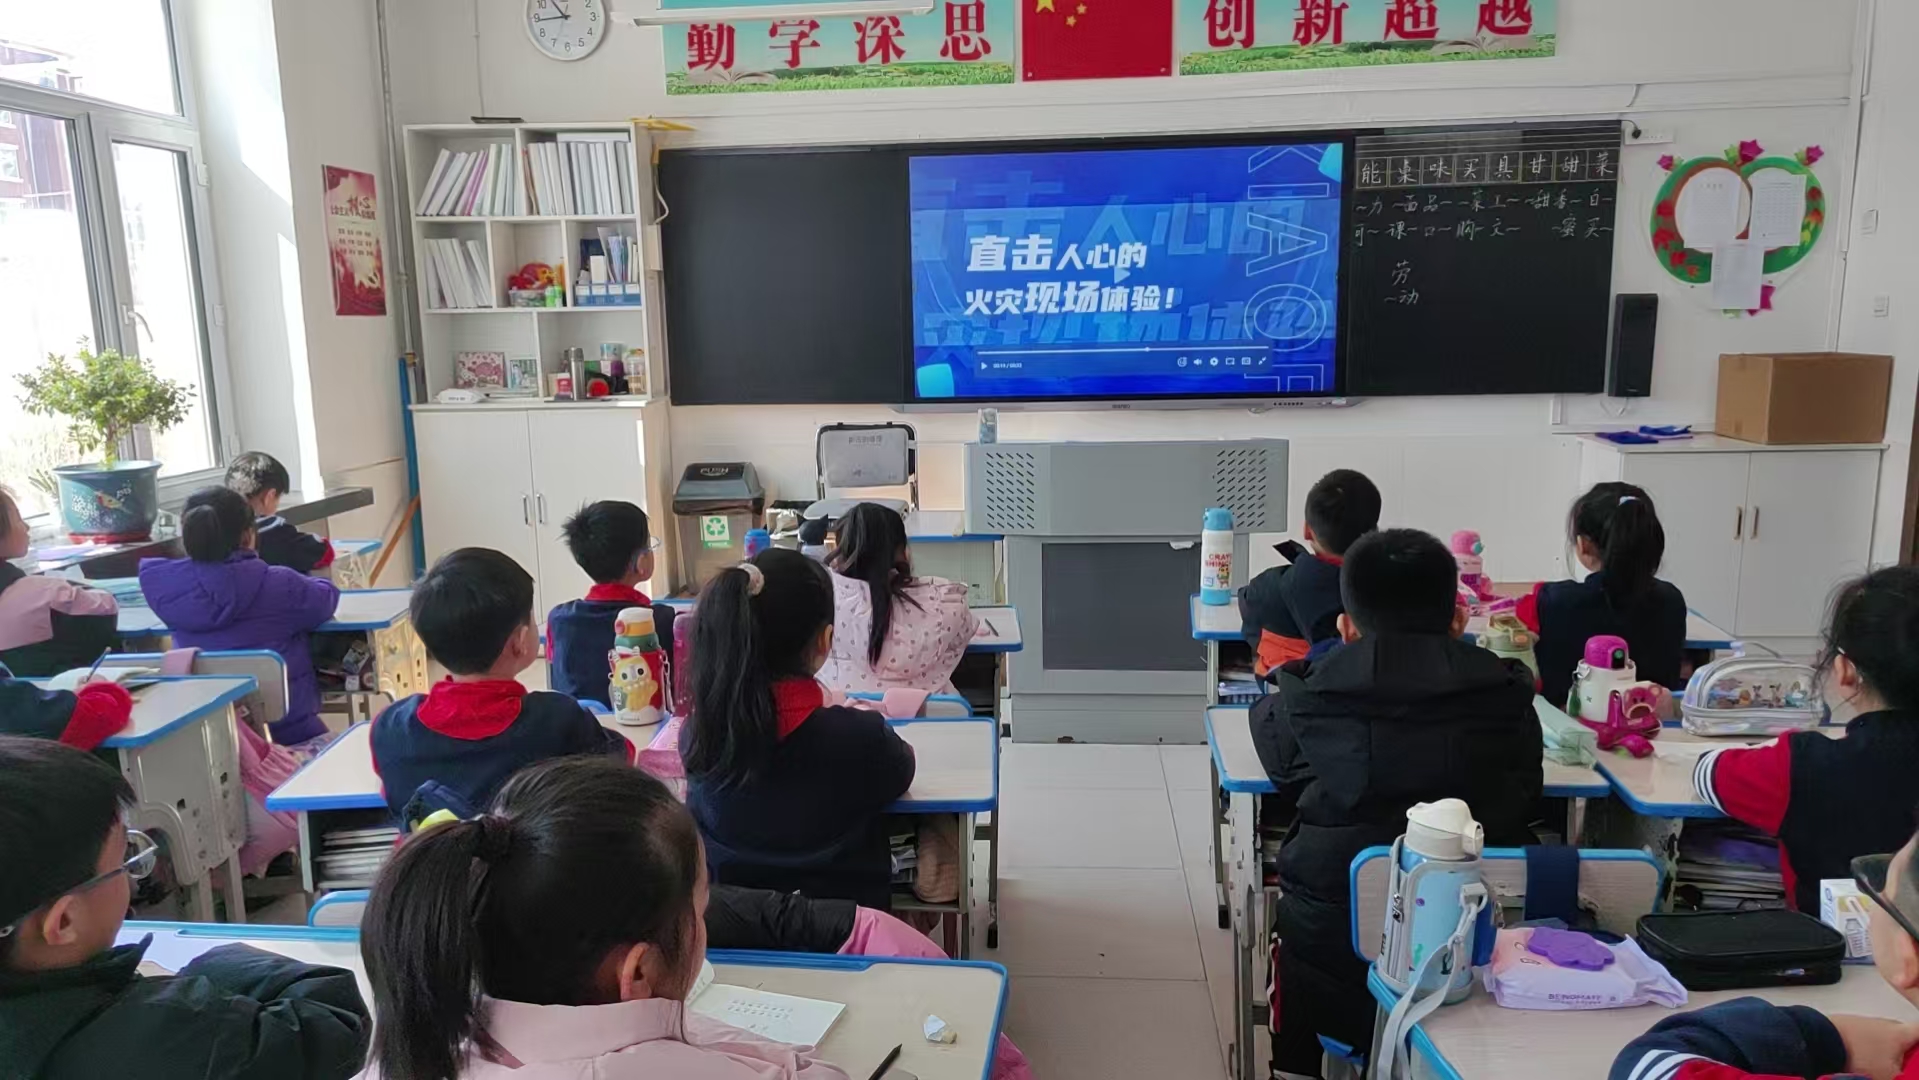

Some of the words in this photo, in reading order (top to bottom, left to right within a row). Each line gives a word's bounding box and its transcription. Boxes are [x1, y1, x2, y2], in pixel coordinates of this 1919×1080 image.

[590, 12, 596, 21] 3
[1203, 0, 1534, 49] 创新超越
[539, 28, 546, 37] 8
[587, 27, 593, 36] 4
[551, 38, 557, 47] 7
[564, 42, 571, 52] 6
[578, 38, 585, 47] 5
[966, 233, 1148, 272] 直击人心的
